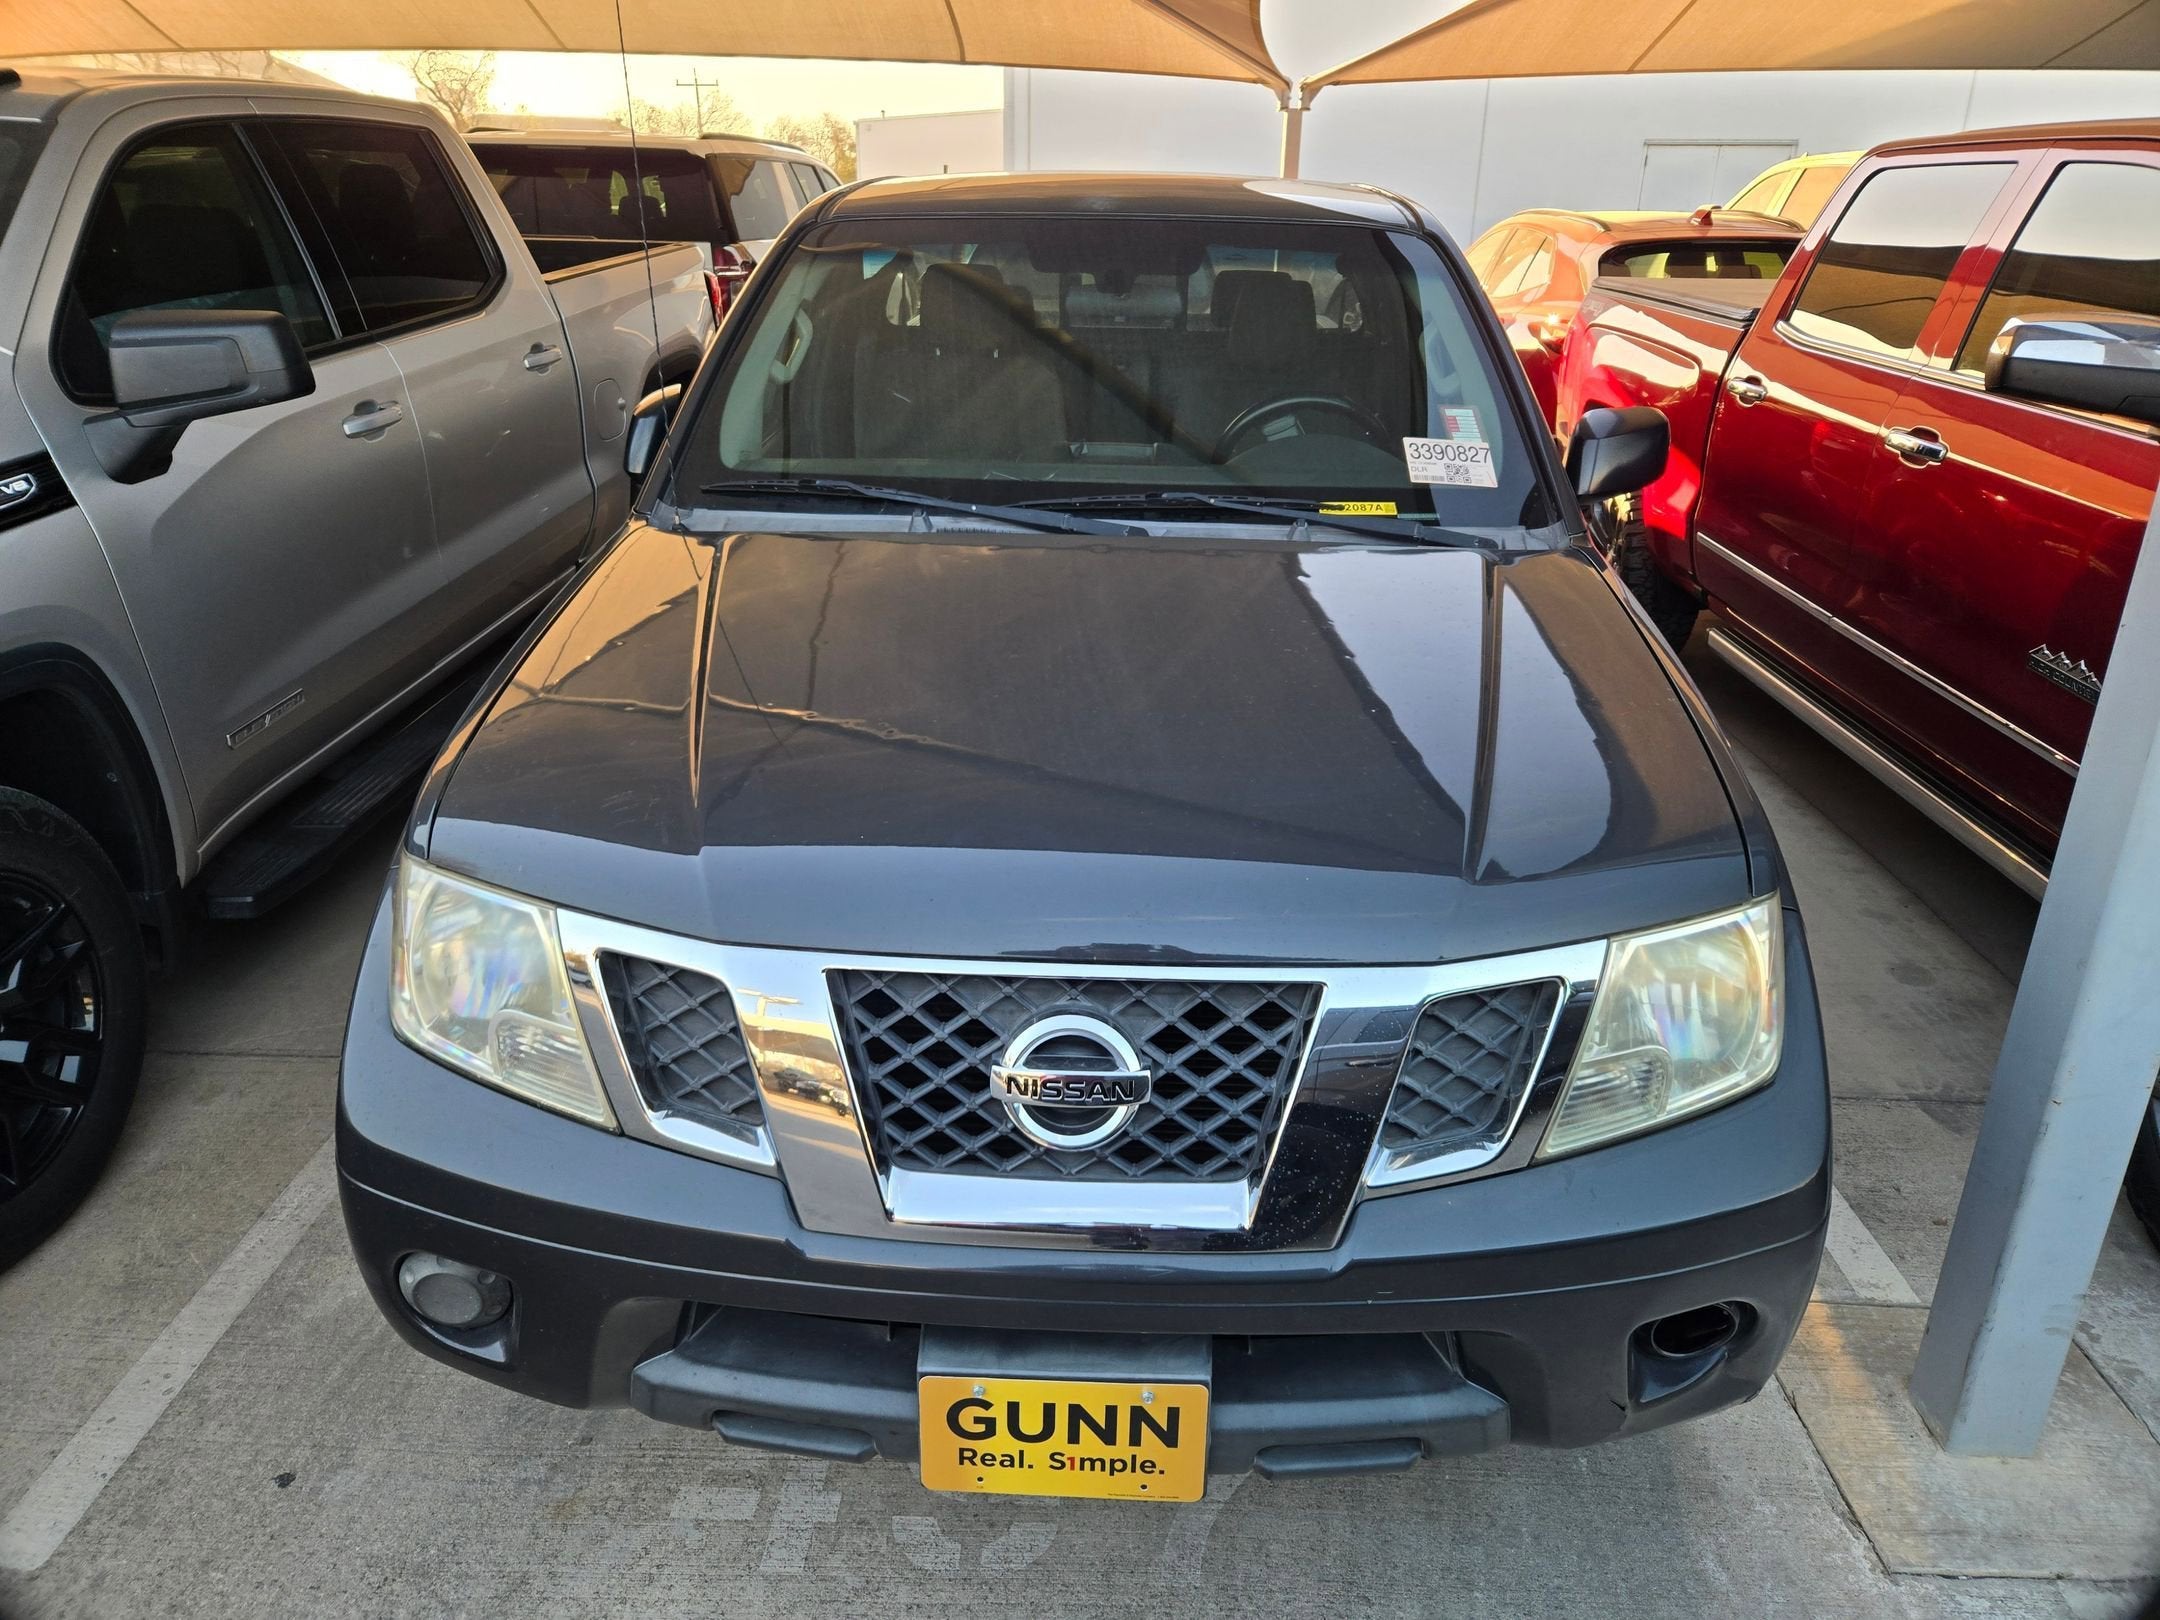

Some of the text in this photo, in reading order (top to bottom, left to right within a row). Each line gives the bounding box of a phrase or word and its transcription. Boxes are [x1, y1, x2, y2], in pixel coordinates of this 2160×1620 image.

[1408, 442, 1489, 464] 3390827
[0, 479, 30, 495] V8
[1005, 1074, 1135, 1102] NISSAN
[946, 1397, 1180, 1448] GUNN
[958, 1447, 1165, 1477] Real. S1mple.
